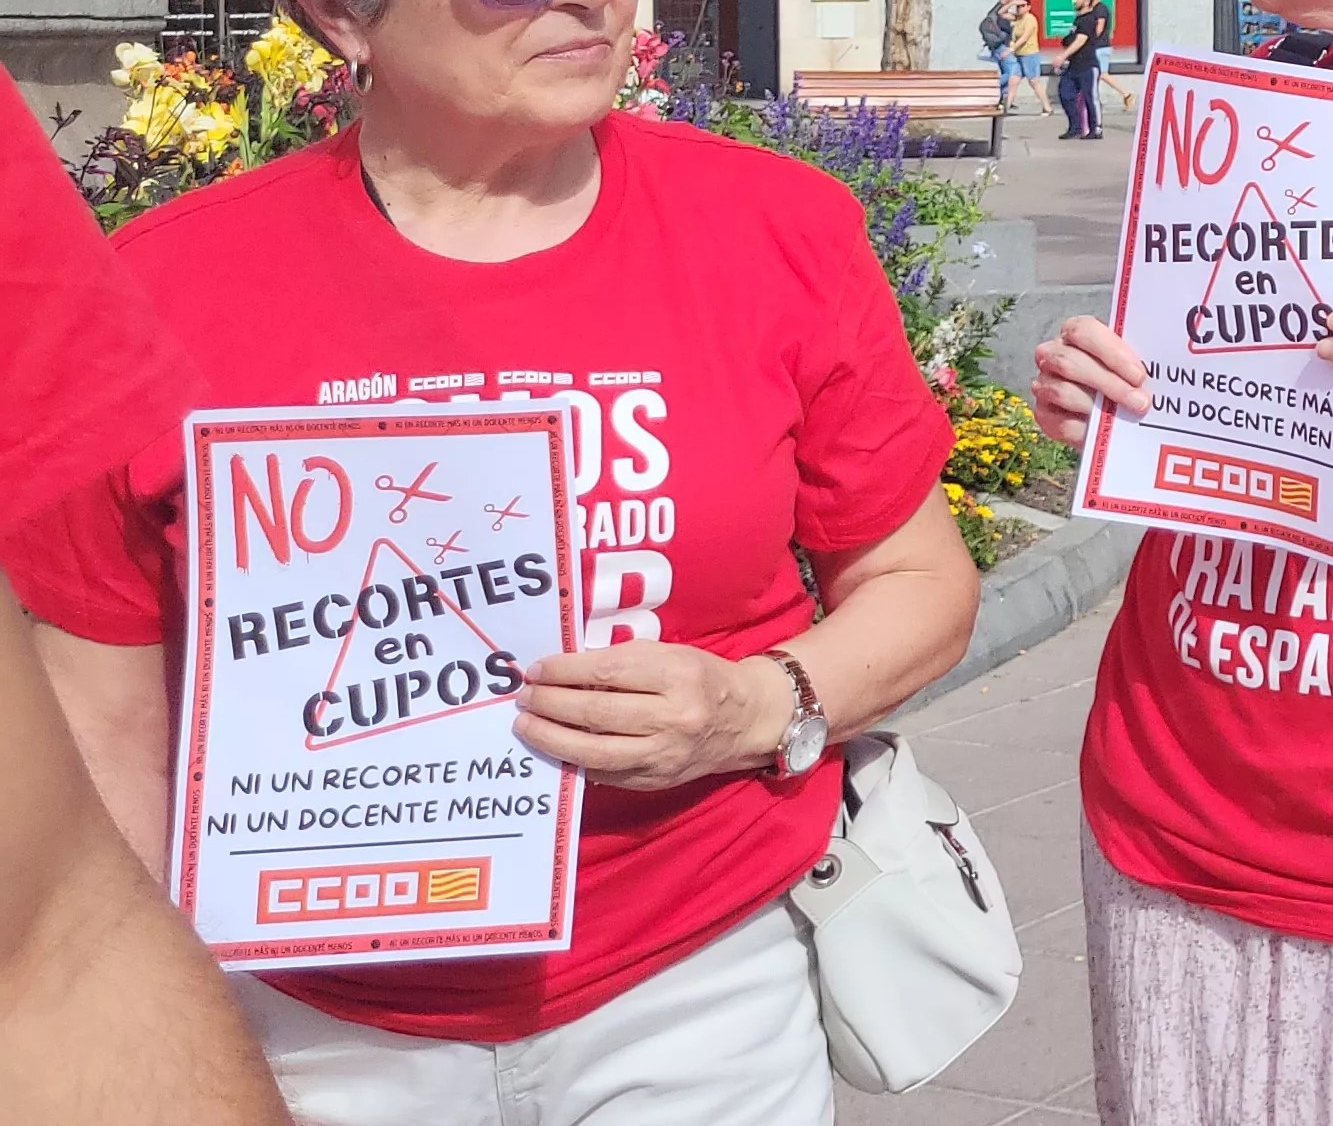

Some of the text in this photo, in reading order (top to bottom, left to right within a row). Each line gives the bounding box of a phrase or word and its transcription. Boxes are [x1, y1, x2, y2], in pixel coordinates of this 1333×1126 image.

[1155, 84, 1240, 189] NO
[1235, 270, 1277, 295] en
[1186, 303, 1333, 345] CUPOS
[318, 371, 397, 404] ARAGÓN
[1167, 365, 1195, 386] UN
[1203, 372, 1297, 408] RECORTE
[1152, 394, 1181, 415] UN
[1188, 400, 1285, 437] DOCENTE
[1163, 454, 1274, 501] CCOO
[230, 452, 354, 575] NO
[227, 552, 553, 661] RECORTES
[373, 631, 434, 664] en
[302, 651, 525, 738] CUPOS
[231, 748, 534, 796] NI UN RECORTE MÁS
[207, 794, 551, 836] NI UN DOCENTE MENOS
[268, 872, 420, 913] CCOO
